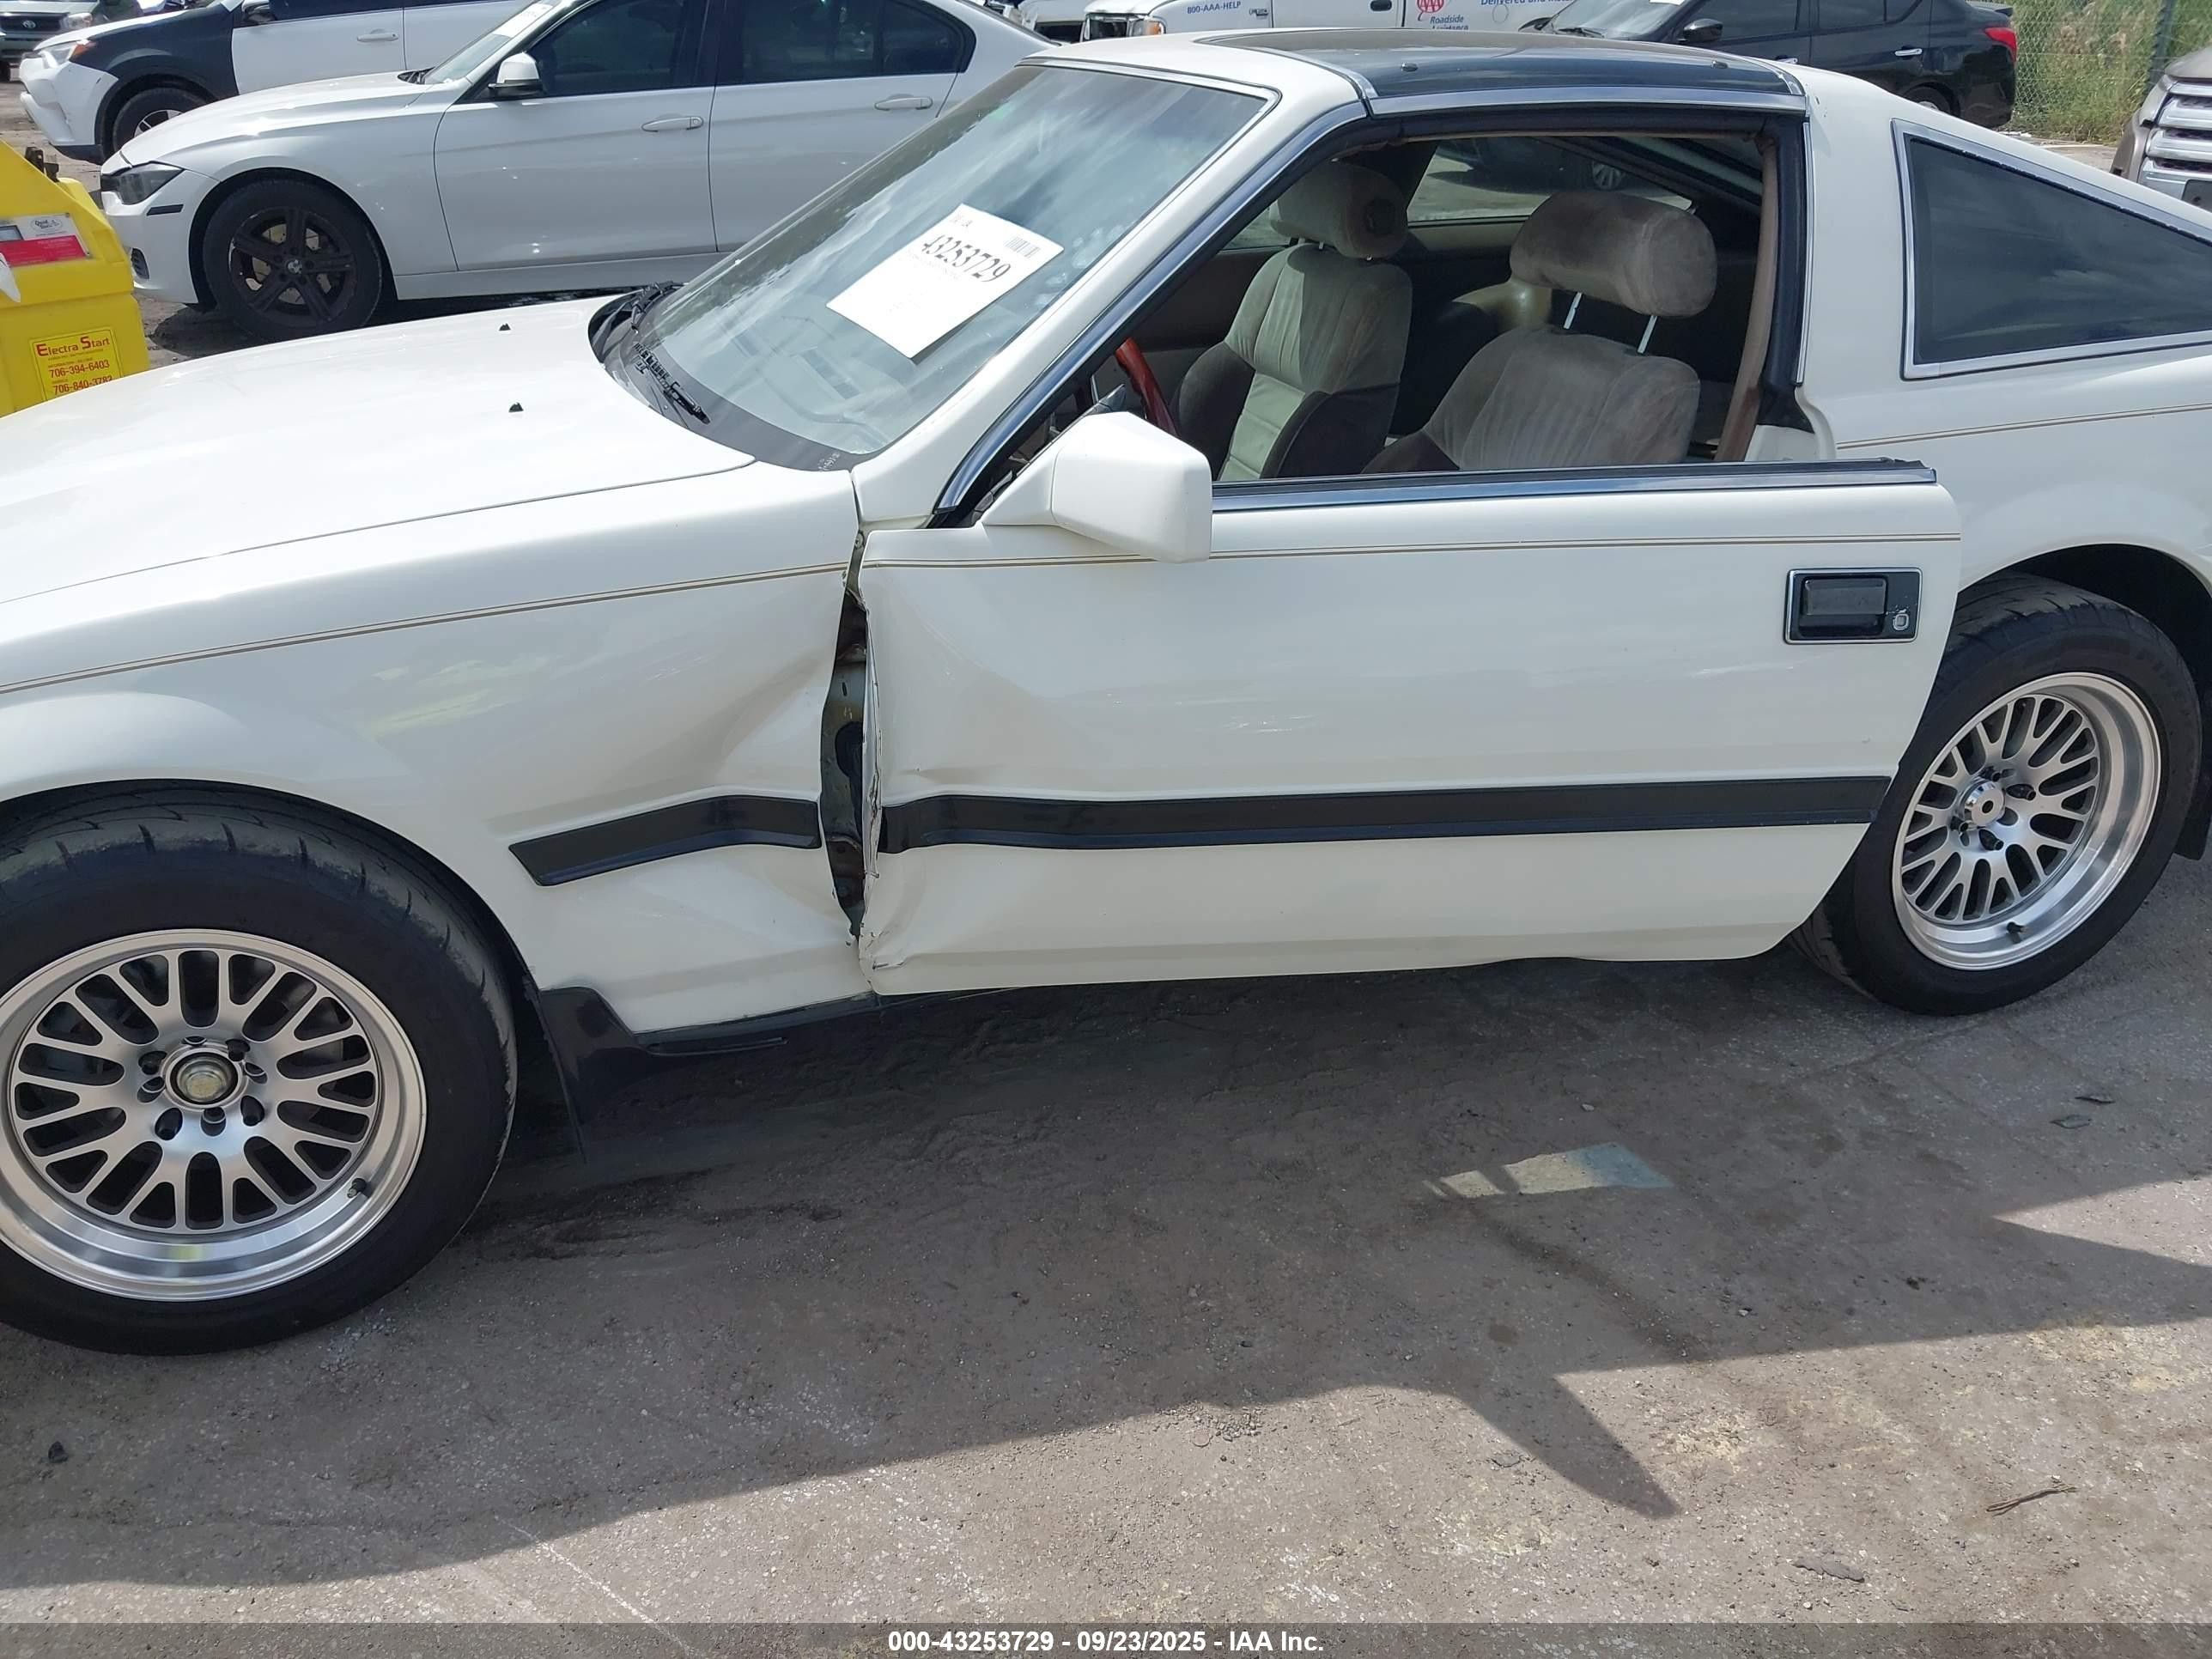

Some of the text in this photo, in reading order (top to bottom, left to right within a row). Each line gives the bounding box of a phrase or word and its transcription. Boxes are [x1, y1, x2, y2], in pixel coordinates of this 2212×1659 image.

[1187, 2, 1241, 15] 800-AAA-HELP
[1430, 15, 1464, 24] Roadside
[921, 234, 1012, 283] 43253729
[36, 343, 79, 357] Electra
[80, 336, 110, 349] Start
[49, 359, 110, 378] 706-394-6403
